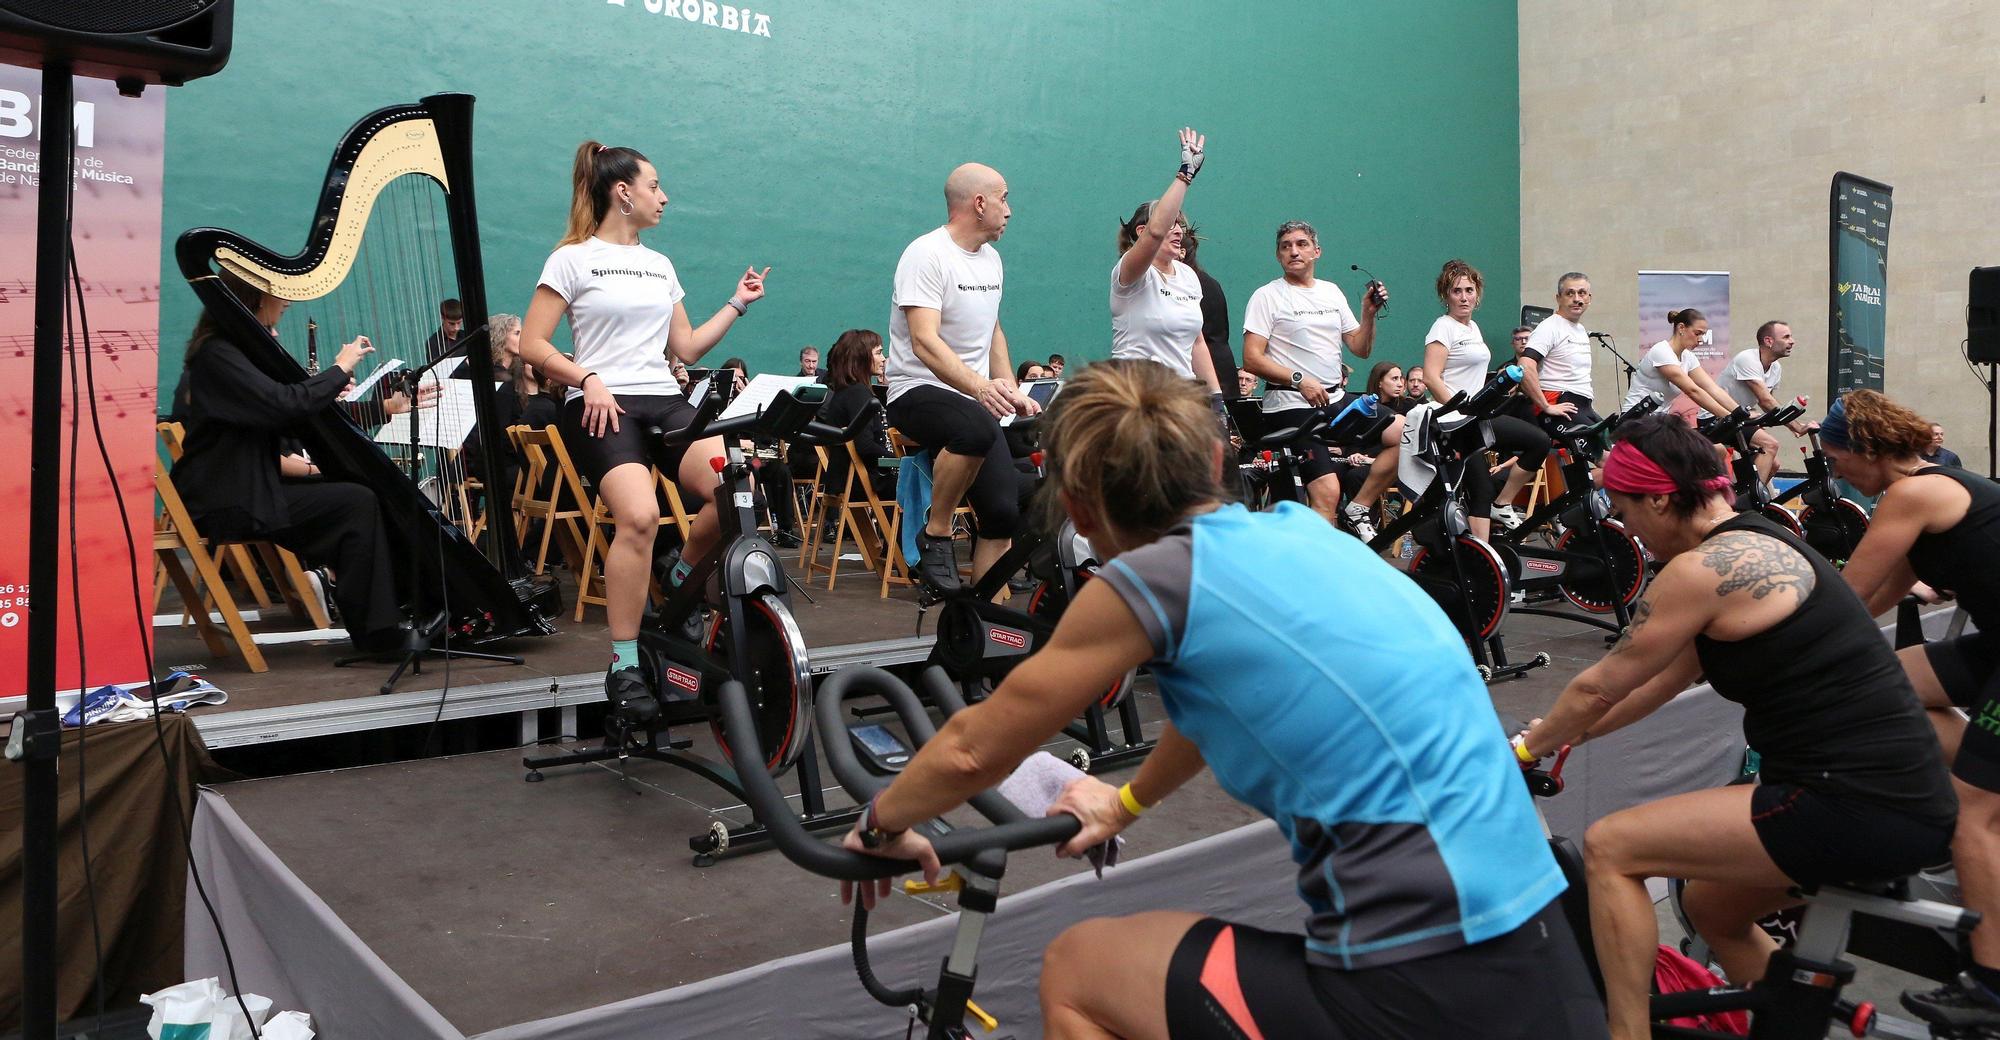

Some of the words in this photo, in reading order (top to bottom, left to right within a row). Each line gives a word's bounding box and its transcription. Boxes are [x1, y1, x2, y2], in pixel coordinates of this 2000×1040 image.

[84, 156, 104, 169] de
[82, 168, 134, 185] Música
[742, 495, 748, 504] 3
[992, 632, 1007, 640] STAR
[1007, 635, 1023, 645] TRAC
[669, 671, 682, 682] STAR
[681, 676, 696, 687] TRAC
